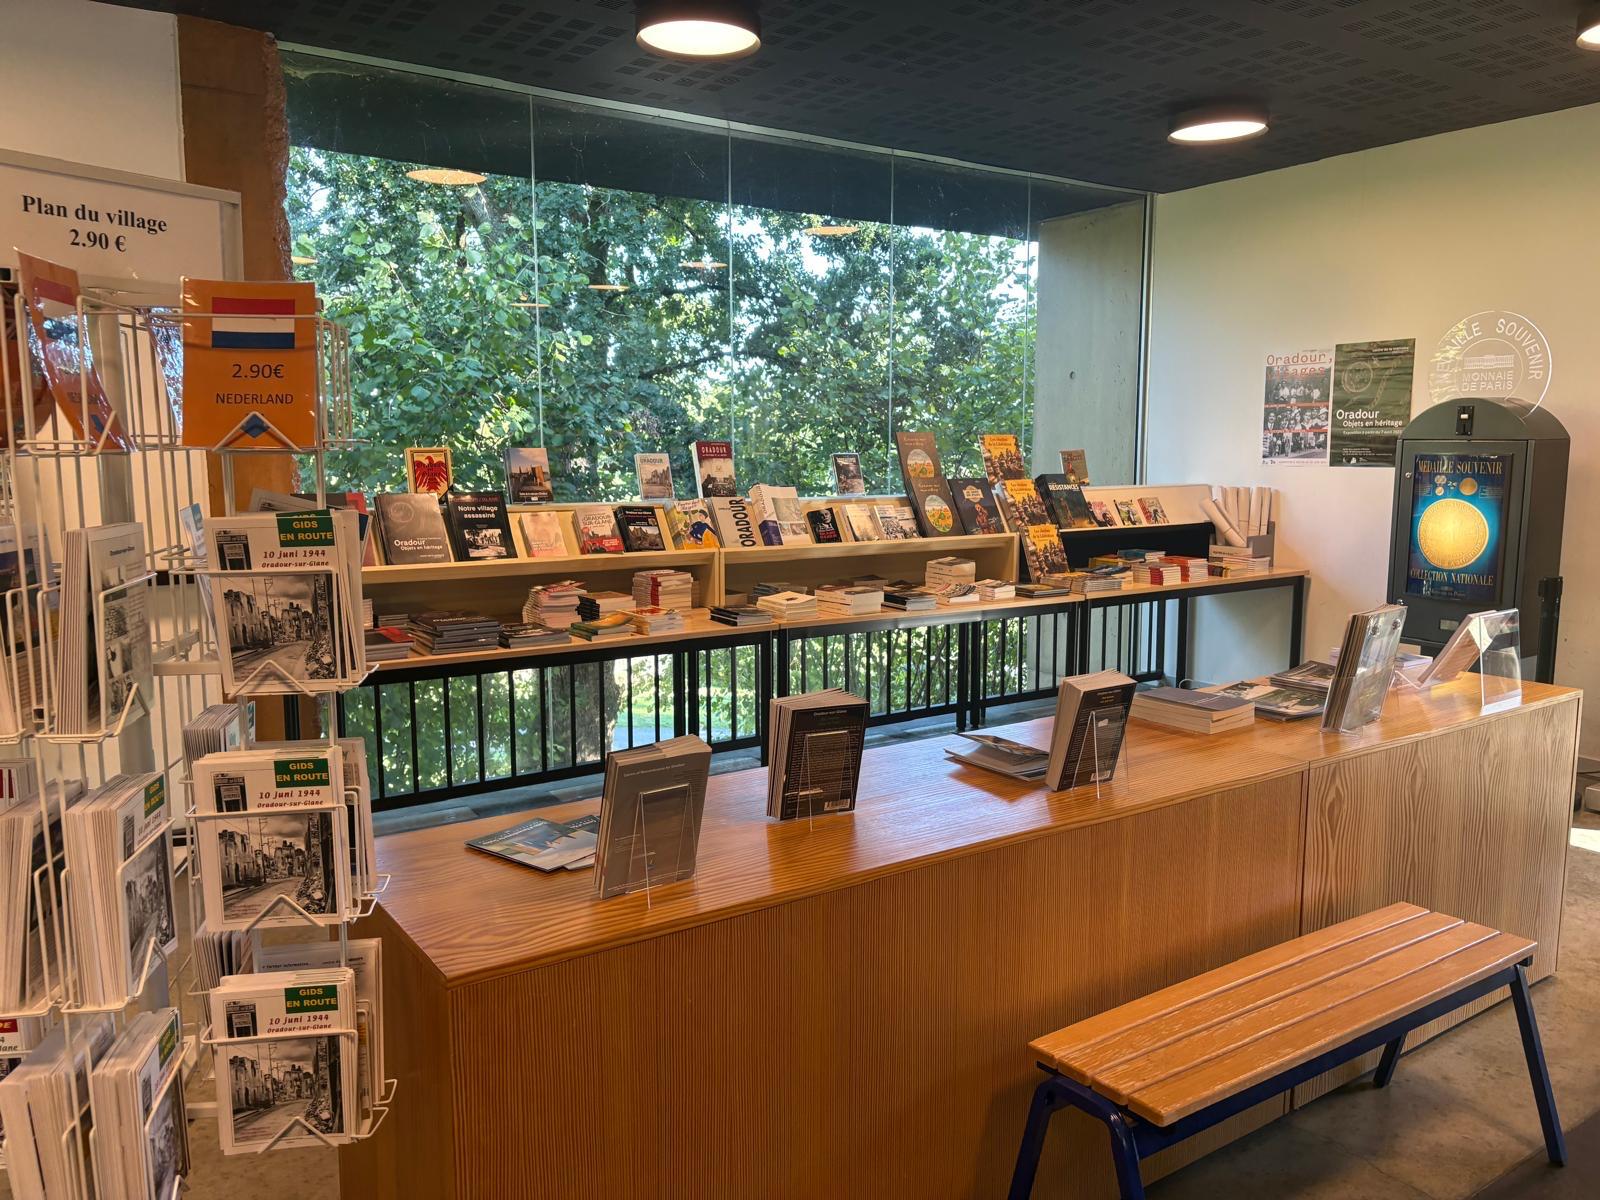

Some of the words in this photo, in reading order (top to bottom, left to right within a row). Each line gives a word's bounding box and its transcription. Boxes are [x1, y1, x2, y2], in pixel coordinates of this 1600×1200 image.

[21, 194, 68, 219] Plan
[74, 203, 100, 224] du
[106, 209, 168, 235] village
[69, 229, 109, 250] 2.90
[115, 235, 127, 252] €
[1495, 318, 1543, 380] SOUVENIR
[232, 363, 284, 379] 2.90€
[1462, 370, 1513, 382] MONNAIE
[1462, 382, 1478, 391] DE
[1480, 380, 1513, 390] PARIS
[216, 392, 294, 406] NEDERLAND
[1336, 409, 1379, 419] Oradour
[1343, 420, 1363, 428] Objets
[701, 446, 727, 454] ORADOUR
[1456, 460, 1503, 475] SOUVENIR
[292, 520, 318, 529] GIDS
[729, 499, 756, 547] ORADOUR
[280, 533, 294, 541] EN
[298, 531, 334, 540] ROUTE
[394, 539, 425, 547] Oradour
[263, 551, 275, 559] 10
[277, 551, 298, 560] juni
[303, 549, 326, 558] 1944
[261, 560, 329, 568] Oradour-sur-Glane
[1451, 572, 1494, 586] NATIONALE
[289, 762, 314, 770] GIDS
[276, 774, 291, 782] EN
[294, 773, 329, 781] ROUTE
[259, 791, 270, 799] 10
[273, 791, 293, 800] juni
[298, 789, 321, 798] 1944
[257, 800, 323, 808] Oradour-sur-Glane
[299, 988, 323, 996] GIDS
[286, 1000, 300, 1008] EN
[303, 998, 337, 1007] ROUTE
[269, 1017, 280, 1025] 10
[283, 1016, 303, 1025] juni
[307, 1014, 329, 1022] 1944
[267, 1023, 332, 1033] Oradour-sur-Glane
